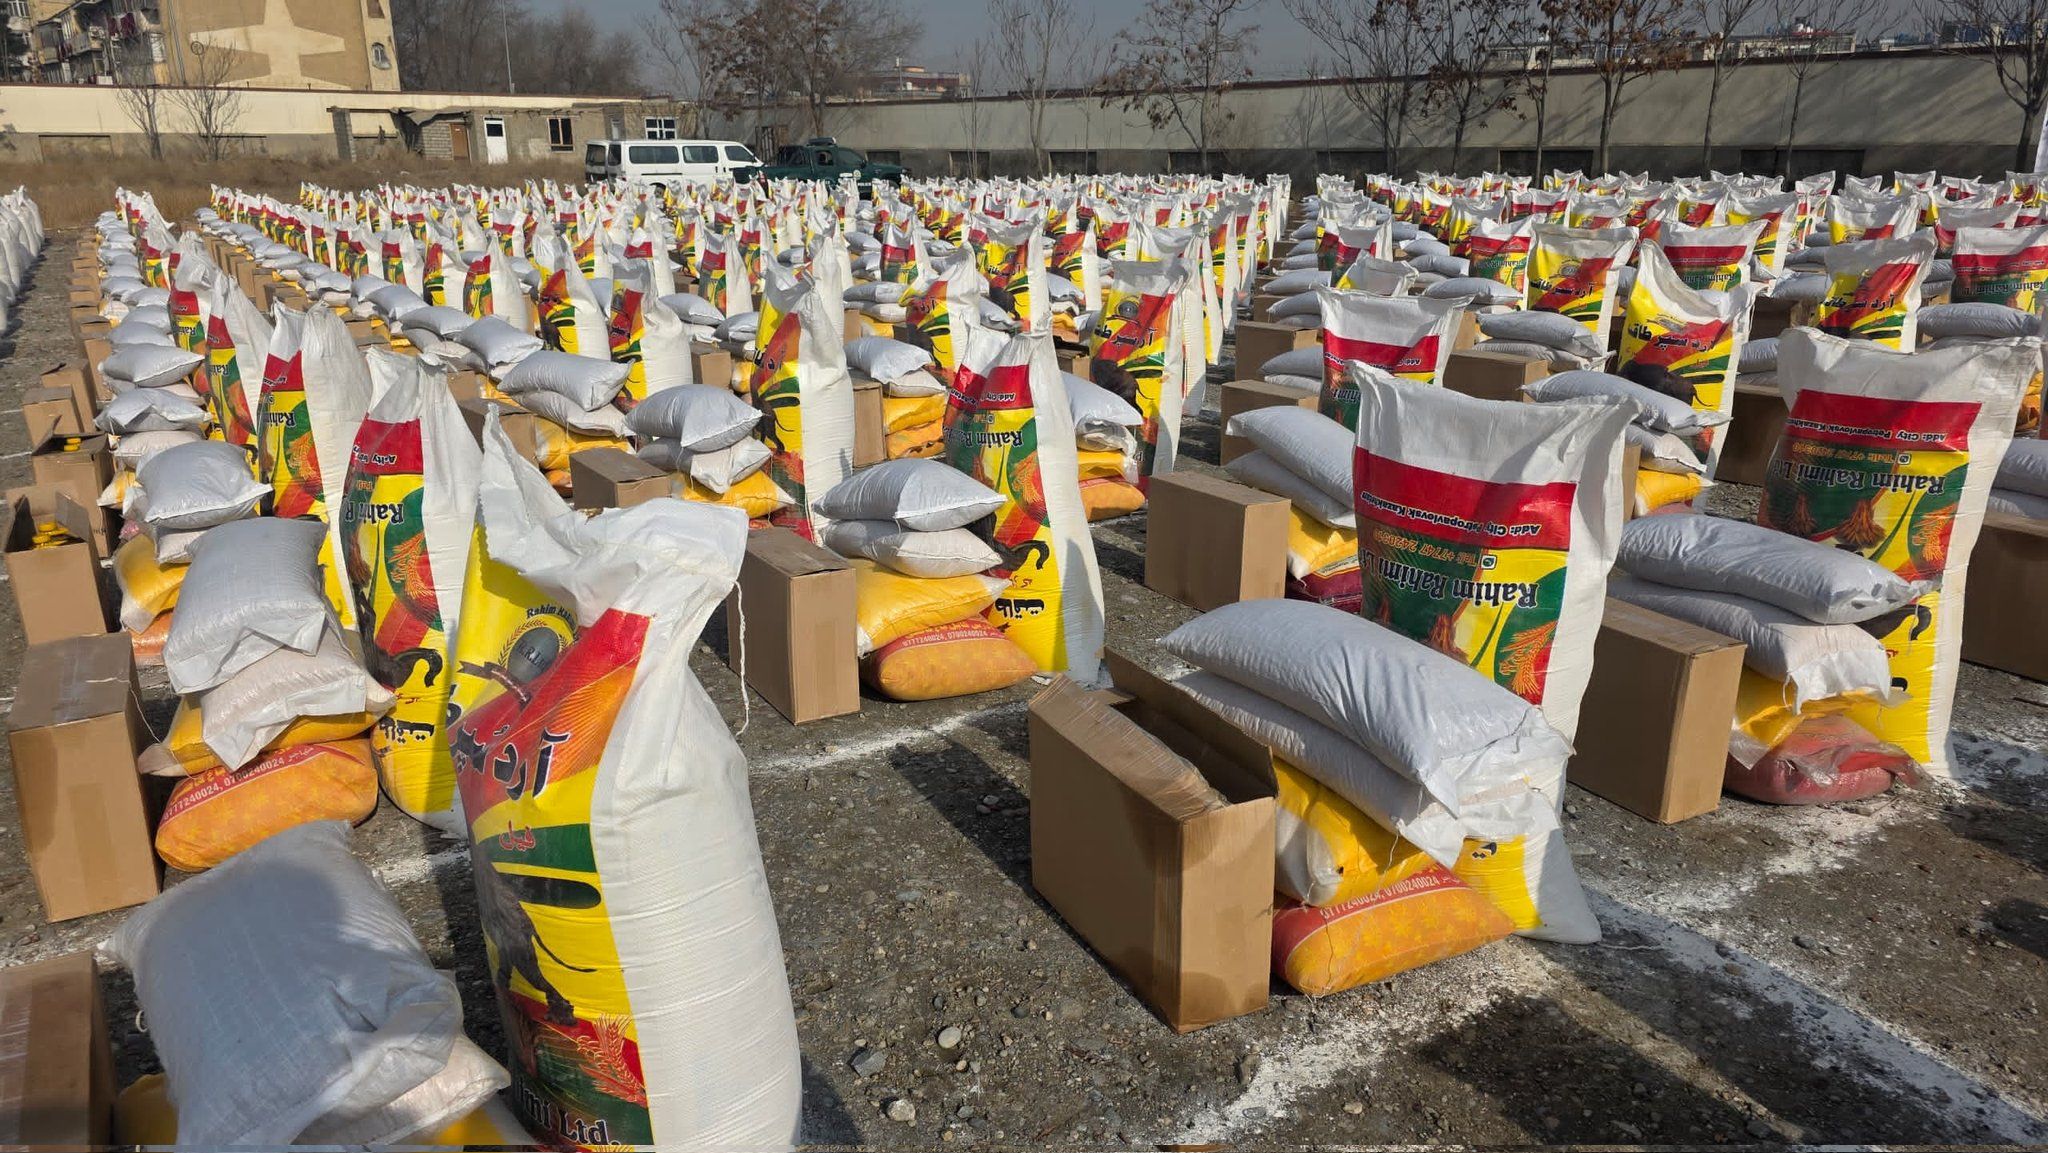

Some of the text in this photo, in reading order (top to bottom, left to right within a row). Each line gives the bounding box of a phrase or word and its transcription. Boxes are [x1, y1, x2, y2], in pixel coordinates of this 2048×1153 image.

[1896, 431, 1920, 442] City
[1798, 463, 1868, 490] Rahimi
[1871, 472, 1946, 495] Rahim
[1509, 523, 1542, 536] Add:
[1378, 557, 1449, 600] Rahimi
[1451, 579, 1540, 609] Rahim
[526, 603, 557, 619] Rahim
[223, 757, 285, 788] 0700240024
